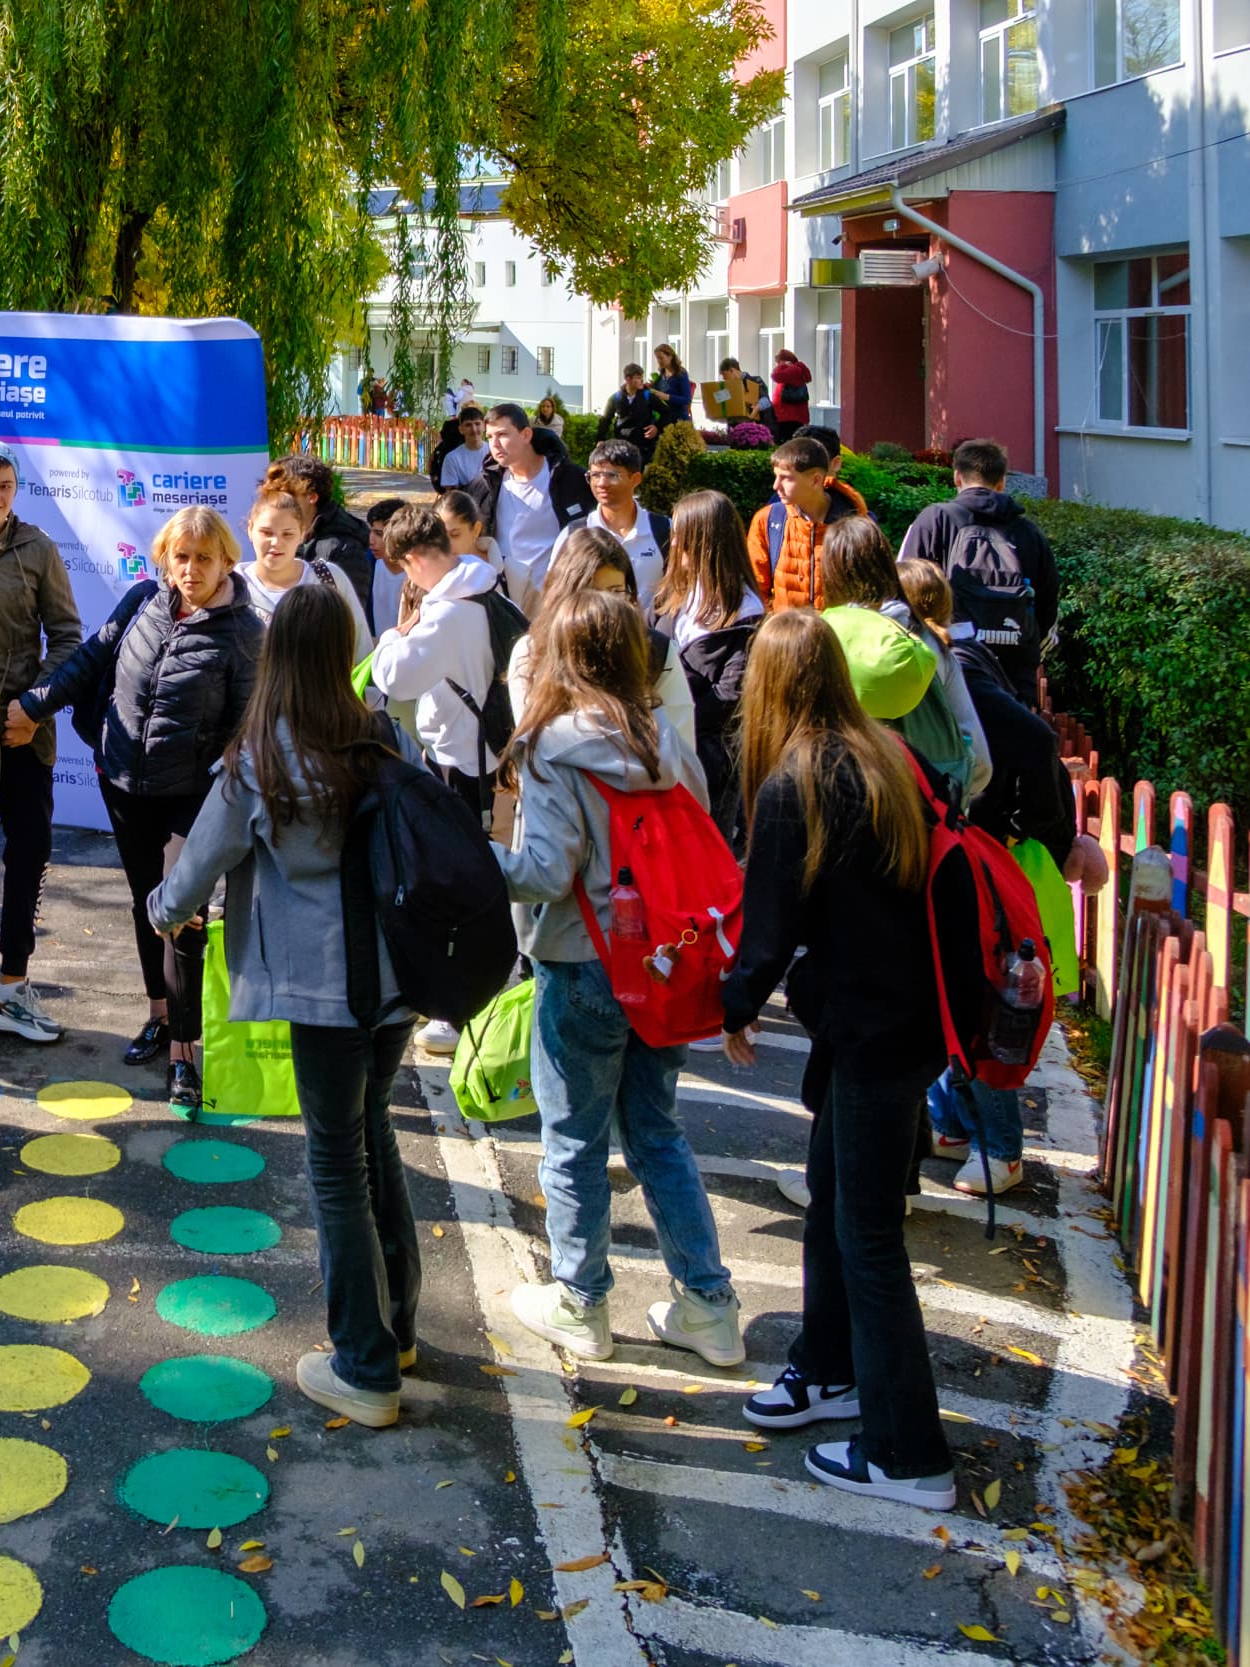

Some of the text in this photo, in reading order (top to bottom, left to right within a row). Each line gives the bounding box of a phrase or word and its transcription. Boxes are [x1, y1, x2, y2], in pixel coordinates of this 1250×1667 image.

[49, 468, 90, 481] powered by
[152, 471, 227, 490] cariere
[152, 492, 228, 507] meseriașe
